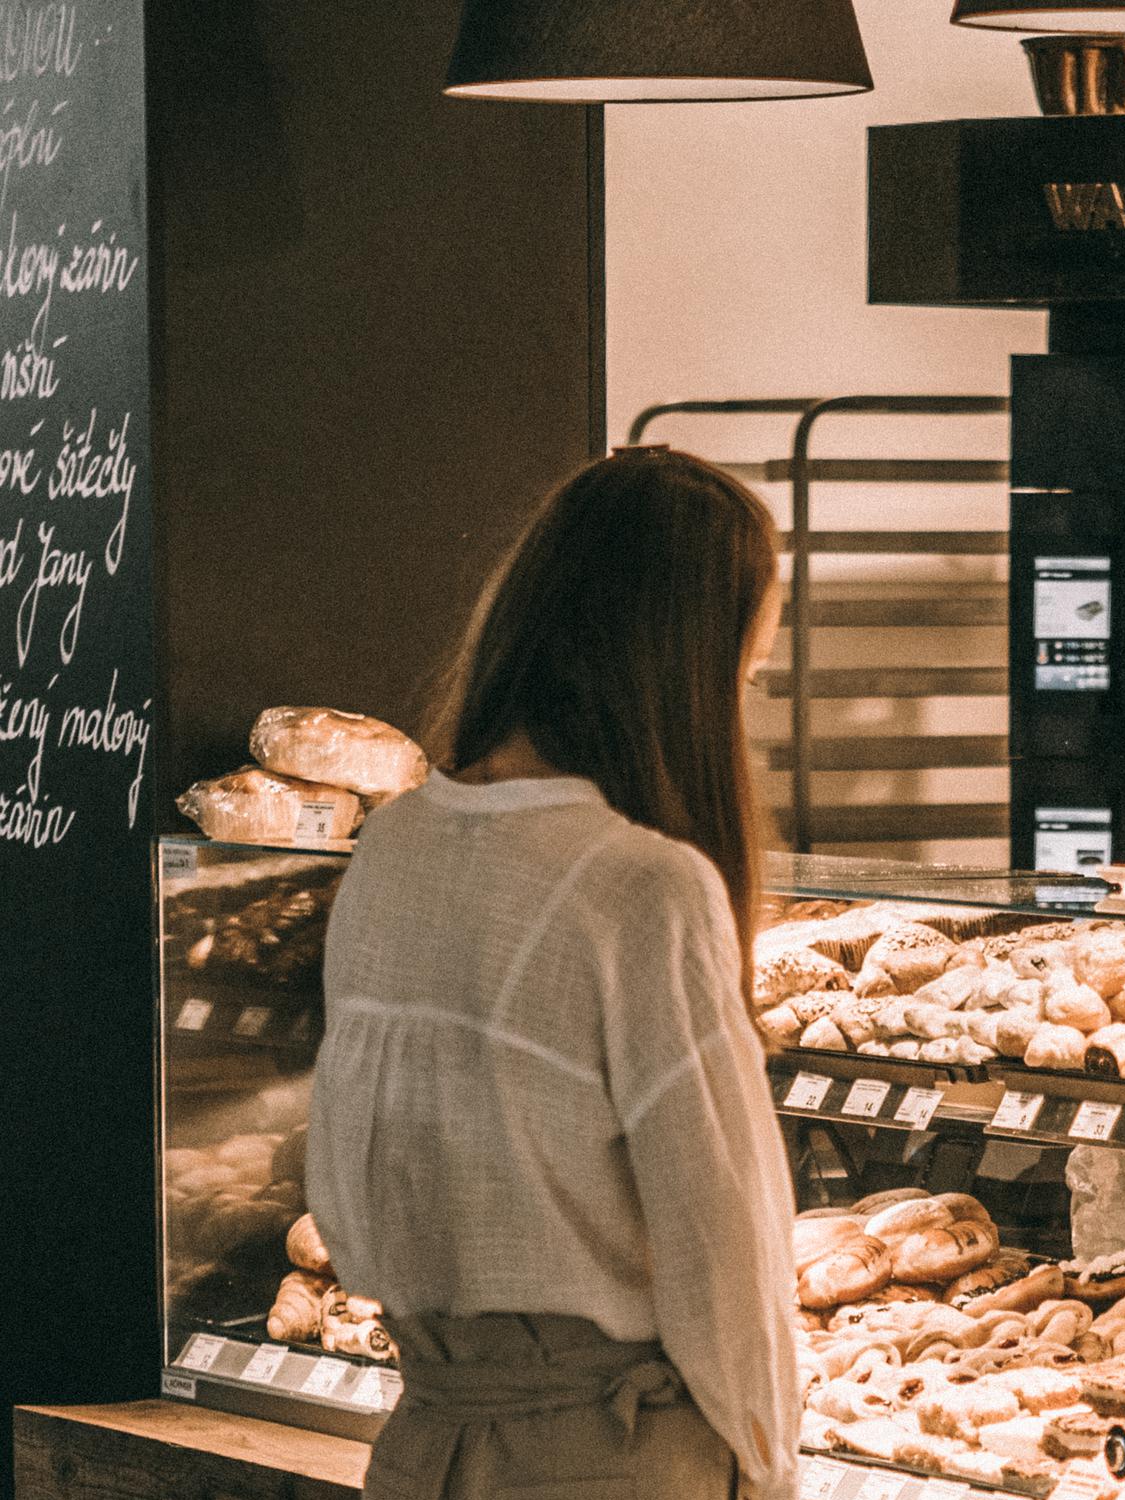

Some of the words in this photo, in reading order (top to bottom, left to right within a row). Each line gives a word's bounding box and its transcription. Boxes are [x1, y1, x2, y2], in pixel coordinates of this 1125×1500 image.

[0, 210, 66, 358] kový
[17, 521, 93, 670] Jany
[58, 668, 152, 830] makový
